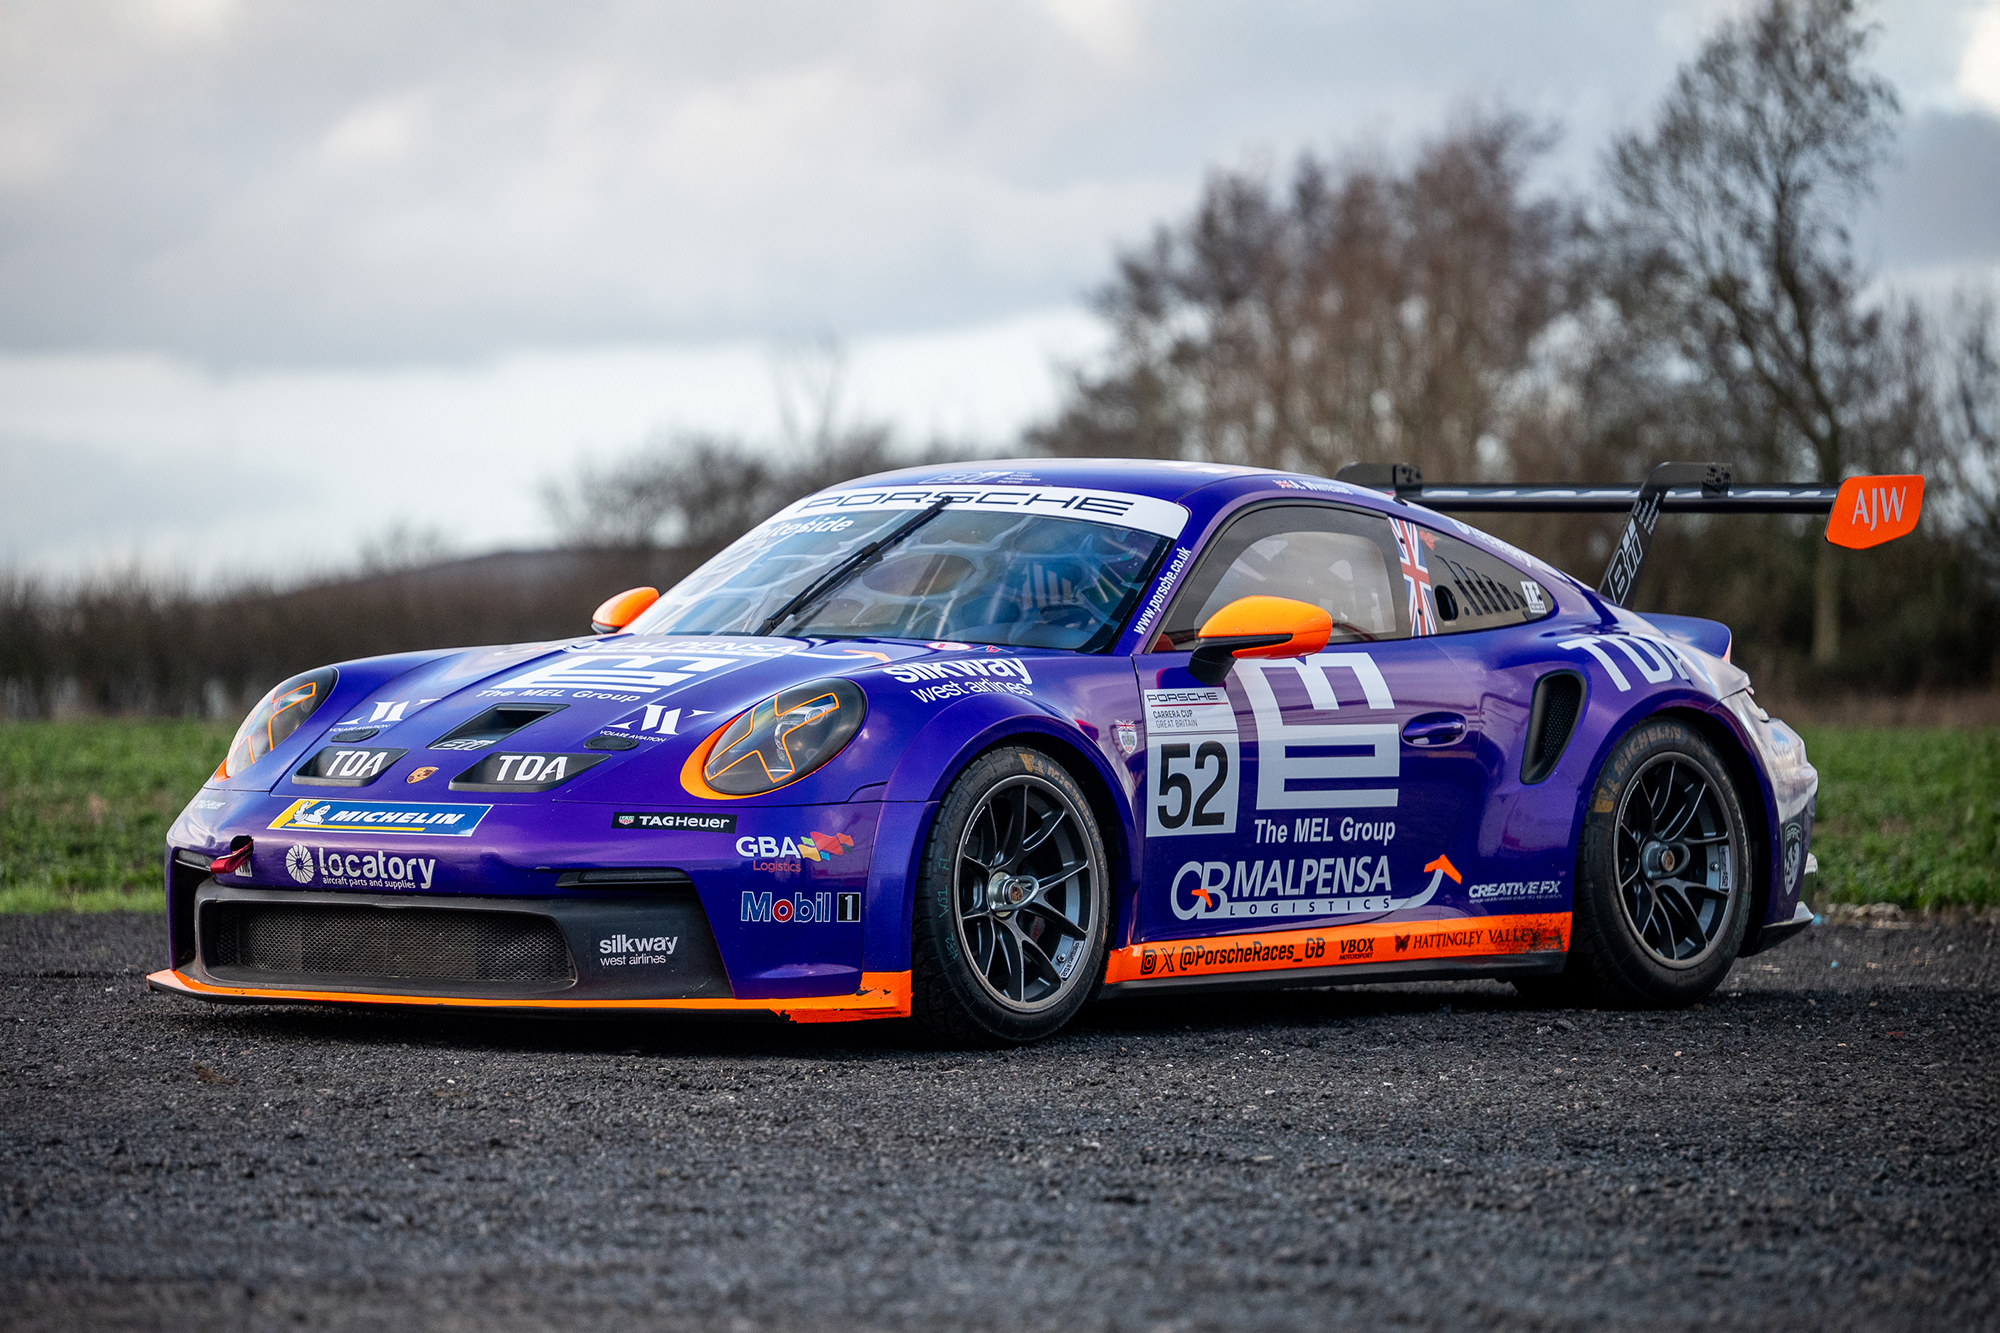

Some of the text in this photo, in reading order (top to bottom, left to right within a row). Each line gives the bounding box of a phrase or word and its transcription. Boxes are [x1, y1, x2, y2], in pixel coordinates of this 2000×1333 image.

[797, 491, 1135, 517] PORSCHE
[1851, 486, 1906, 531] AJW
[1133, 546, 1192, 635] www.porsche.co.uk
[882, 657, 1033, 685] silkway
[476, 689, 641, 703] The MEL Group
[910, 677, 1034, 703] west airlines
[1146, 692, 1218, 702] PORSCHE
[1152, 709, 1193, 719] CARRERA CUP
[1155, 718, 1198, 729] GREAT BRITAIN
[600, 730, 667, 743] VOLARE AVIATION
[326, 750, 388, 777] TDA
[497, 755, 568, 782] TDA
[1157, 740, 1228, 829] 52
[328, 811, 465, 825] MICHELIN
[1254, 816, 1396, 846] The MEL Group
[735, 836, 801, 859] GBA
[318, 847, 436, 890] locatory
[753, 860, 802, 873] Logistics
[1232, 856, 1392, 897] MALPENSA
[322, 876, 416, 890] aircraft parts and supplies
[740, 891, 832, 923] Mobil
[1229, 898, 1390, 916] LOGISTICS
[599, 934, 678, 954] silkway
[1340, 937, 1375, 954] VBOX
[1413, 928, 1540, 949] HATTINGLEY VALLEY
[600, 952, 667, 966] west airlines
[1179, 937, 1326, 971] @PorscheRaces_GB
[1339, 952, 1374, 961] MOTORSPORT
